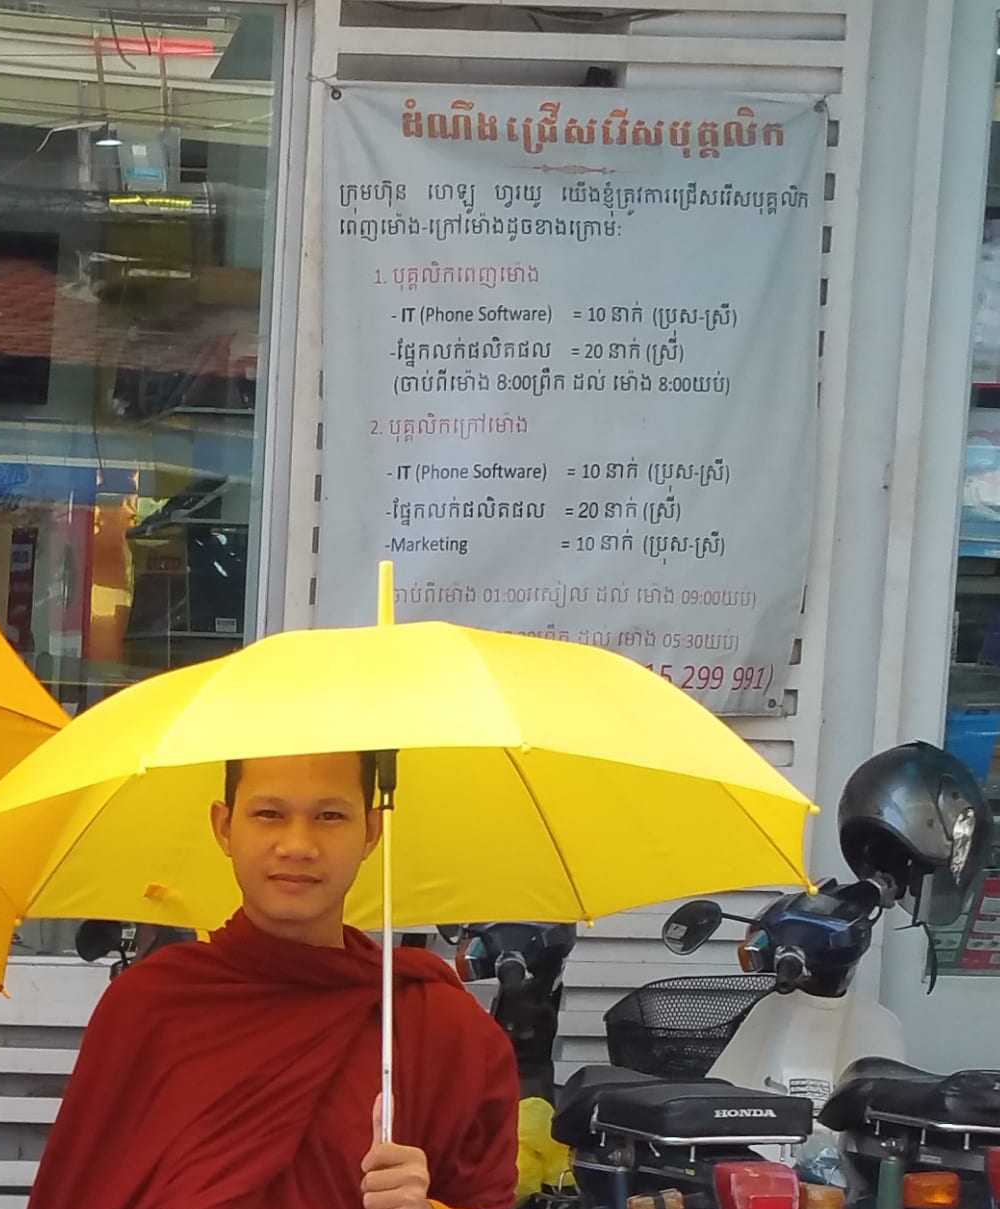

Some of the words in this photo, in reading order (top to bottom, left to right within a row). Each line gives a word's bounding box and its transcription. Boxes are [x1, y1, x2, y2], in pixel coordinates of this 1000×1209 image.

[401, 307, 416, 323] IT
[419, 306, 474, 326] (Phone
[478, 305, 553, 324] Software)
[587, 306, 606, 323] 10
[611, 301, 643, 323] នាក់
[584, 343, 604, 359] 20
[608, 337, 641, 359] នាក់
[397, 464, 412, 481] IT
[415, 463, 469, 484] (Phone
[472, 463, 548, 483] Software)
[581, 463, 601, 480] 10
[605, 456, 639, 479] នាក់
[577, 501, 599, 519] 20
[603, 497, 638, 519] នាក់
[384, 536, 469, 555] -Marketing
[576, 536, 595, 552] 10
[600, 528, 634, 551] នាក់
[680, 665, 725, 691] 299
[730, 663, 774, 697] 991)
[713, 1108, 777, 1118] HONDA
